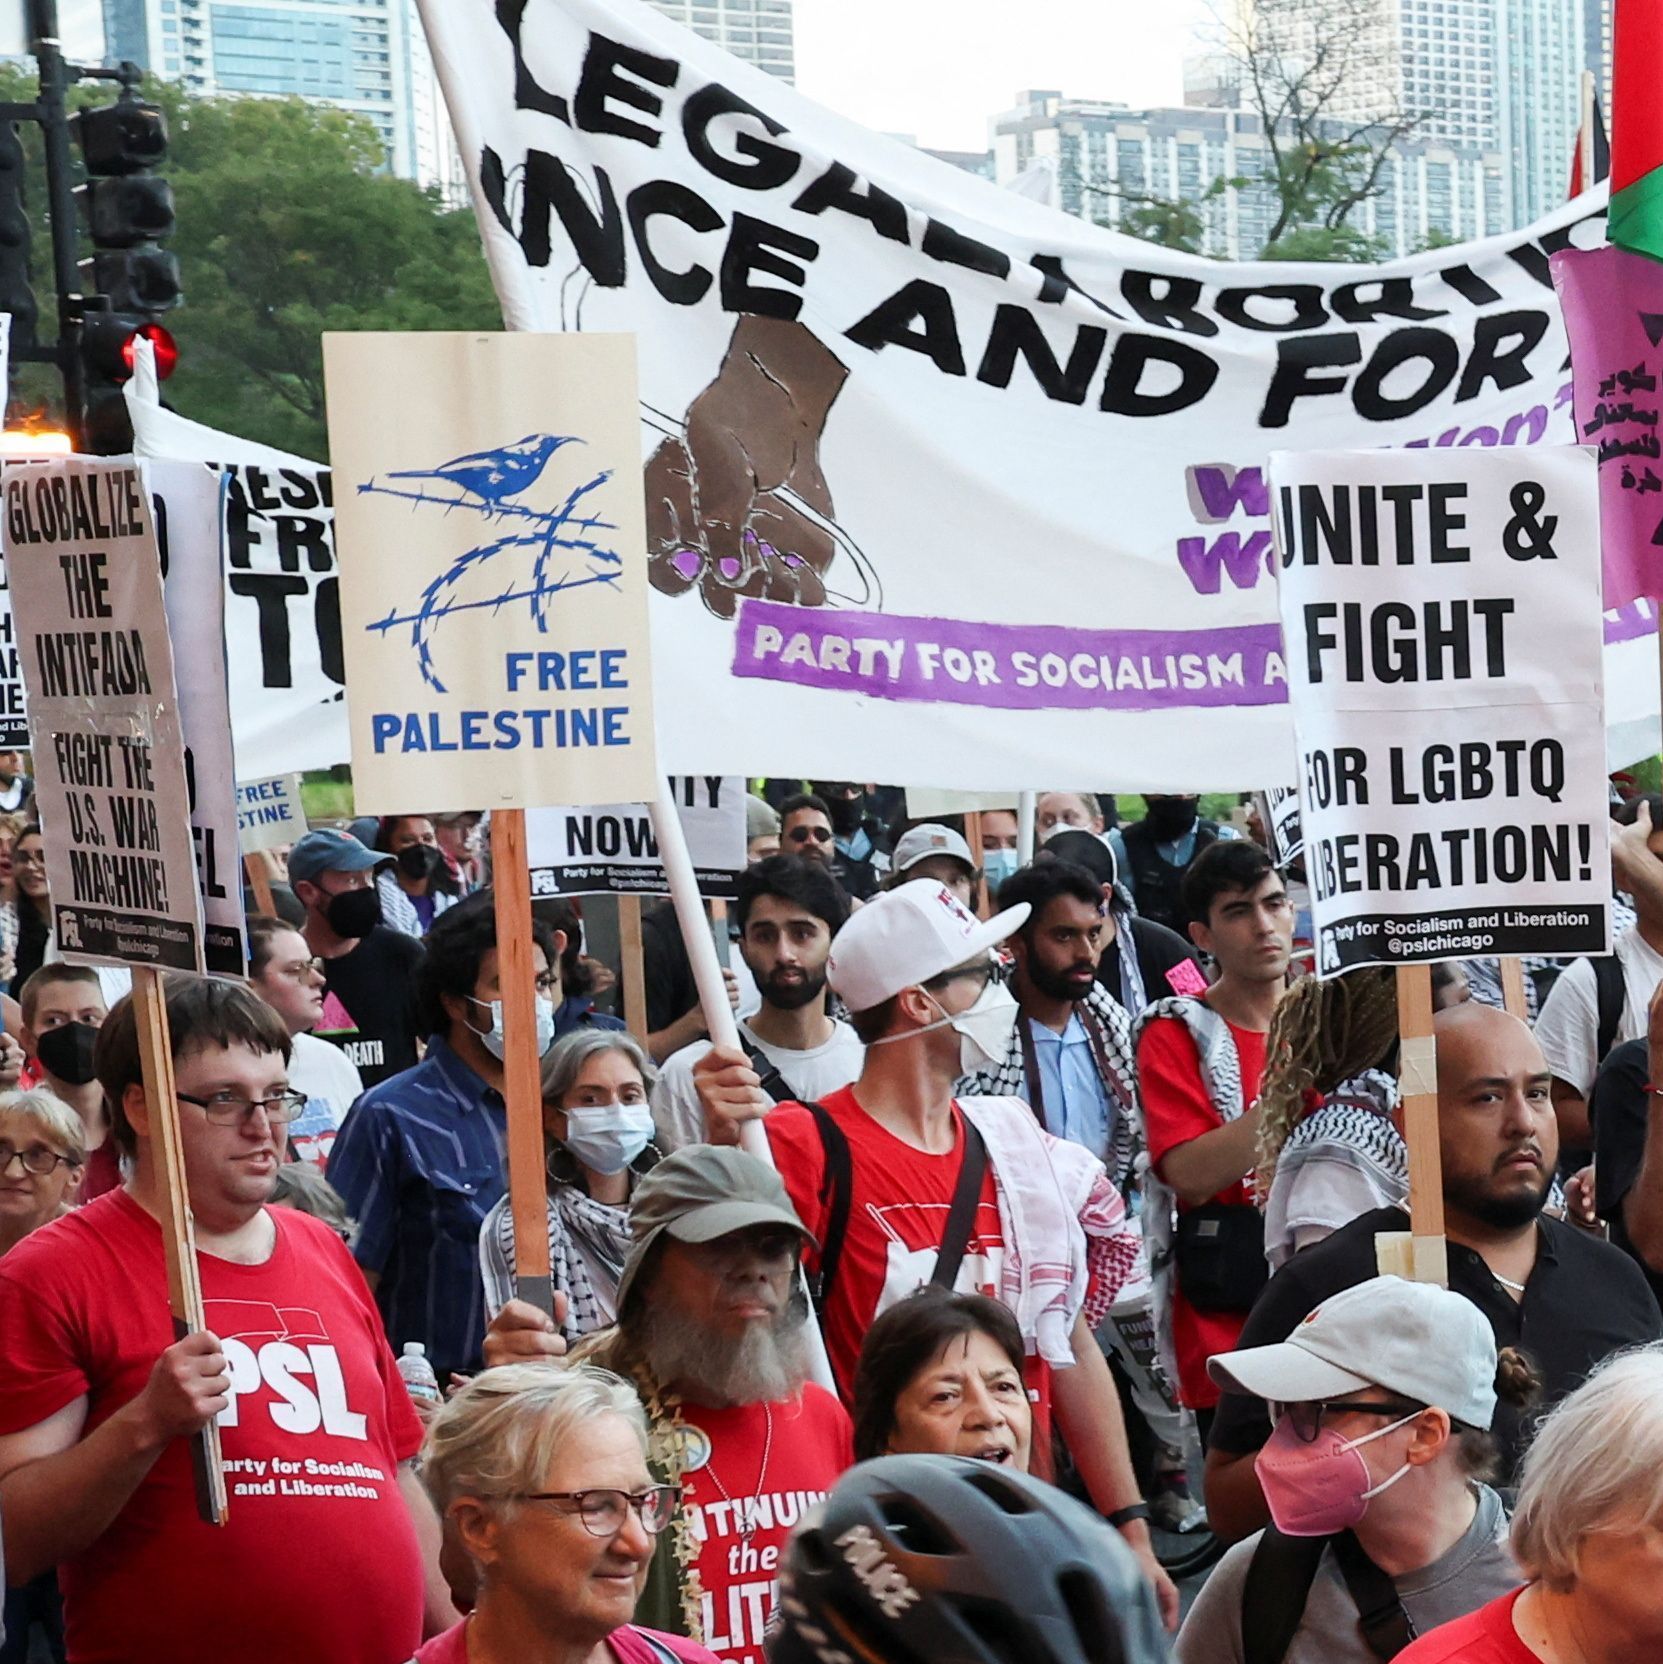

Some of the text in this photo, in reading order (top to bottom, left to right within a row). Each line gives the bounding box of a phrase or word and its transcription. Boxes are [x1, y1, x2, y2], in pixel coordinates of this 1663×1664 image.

[844, 279, 1219, 417] AND
[1258, 310, 1550, 430] FOR
[8, 469, 143, 544] GLOBALIZE
[1502, 481, 1558, 562] &
[59, 554, 113, 619] THE
[506, 650, 628, 692] FREE
[753, 625, 905, 681] PARTY
[919, 642, 1002, 688] FOR
[1013, 652, 1246, 691] SOCIALISM
[1304, 598, 1515, 684] FIGHT
[55, 731, 114, 789] FIGHT
[372, 706, 631, 754] PALESTINE
[1389, 738, 1565, 805] LGBTQ
[66, 793, 161, 853] U.S. WAR
[69, 850, 170, 914] MACHINE!
[563, 867, 588, 880] Party
[1312, 823, 1593, 902] LIBERATION!
[1356, 921, 1380, 938] for
[1384, 915, 1464, 937] Socialism
[1467, 912, 1500, 930] and
[1503, 911, 1589, 928] Liberation
[1388, 933, 1494, 956] @pslchicago
[217, 1338, 368, 1441] PSL
[221, 1457, 385, 1481] arty for Socialism
[234, 1479, 378, 1500] and Liberation
[728, 1545, 778, 1576] the
